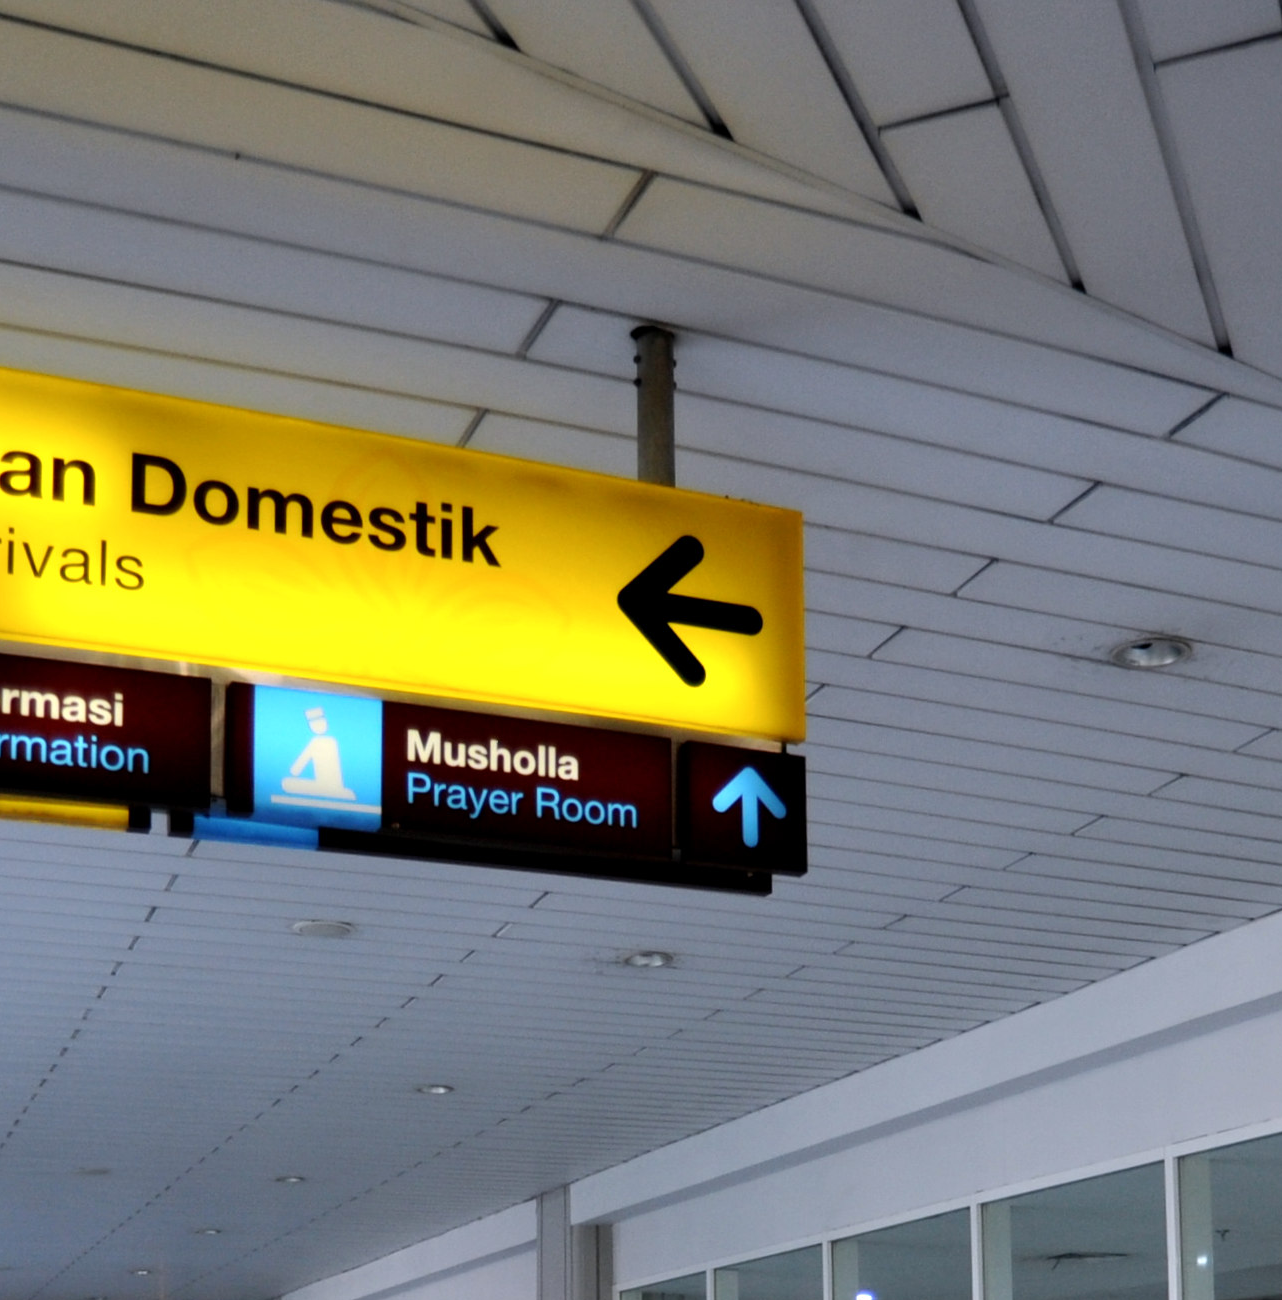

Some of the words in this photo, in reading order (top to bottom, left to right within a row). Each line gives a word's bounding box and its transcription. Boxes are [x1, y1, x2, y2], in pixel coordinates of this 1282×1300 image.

[130, 453, 501, 568] Domestik
[406, 728, 580, 783] Musholla
[406, 774, 527, 825] Prayer
[536, 785, 639, 830] Room
